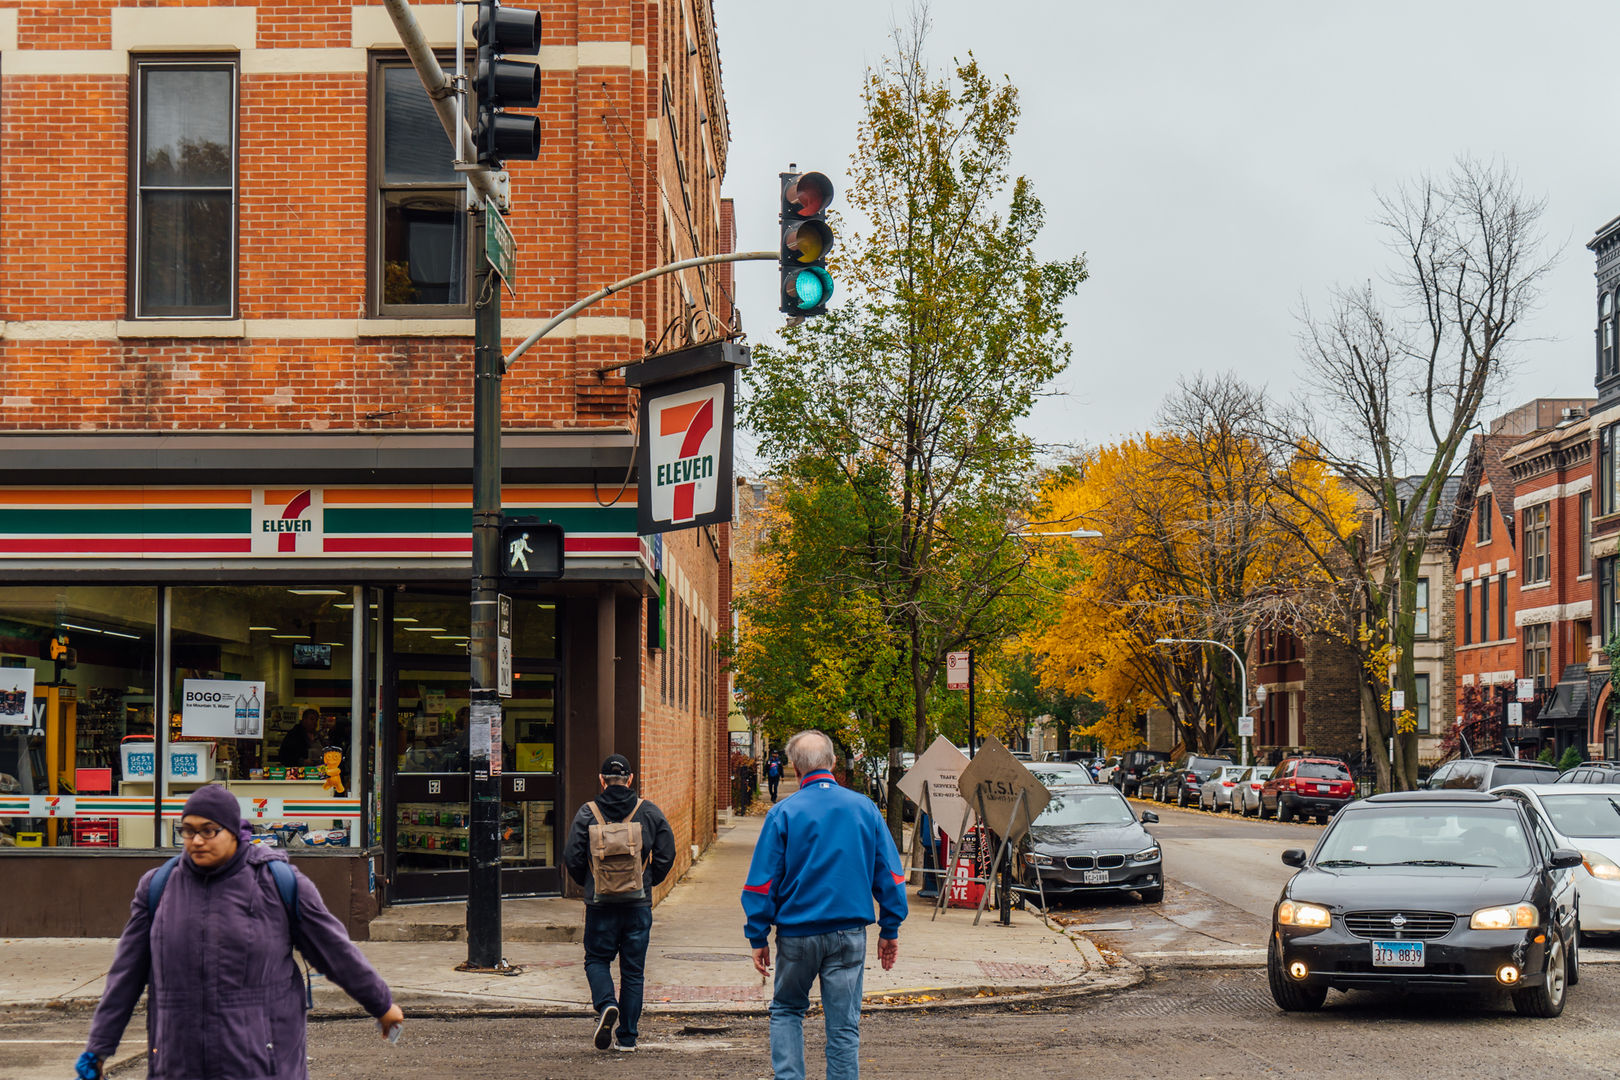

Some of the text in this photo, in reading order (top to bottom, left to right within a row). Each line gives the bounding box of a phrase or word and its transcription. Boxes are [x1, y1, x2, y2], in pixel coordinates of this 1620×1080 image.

[660, 397, 714, 521] 7
[264, 489, 311, 552] 7
[186, 691, 222, 702] BOGO
[45, 797, 60, 816] 7
[253, 798, 268, 817] 7
[1375, 948, 1422, 962] 373 8839
